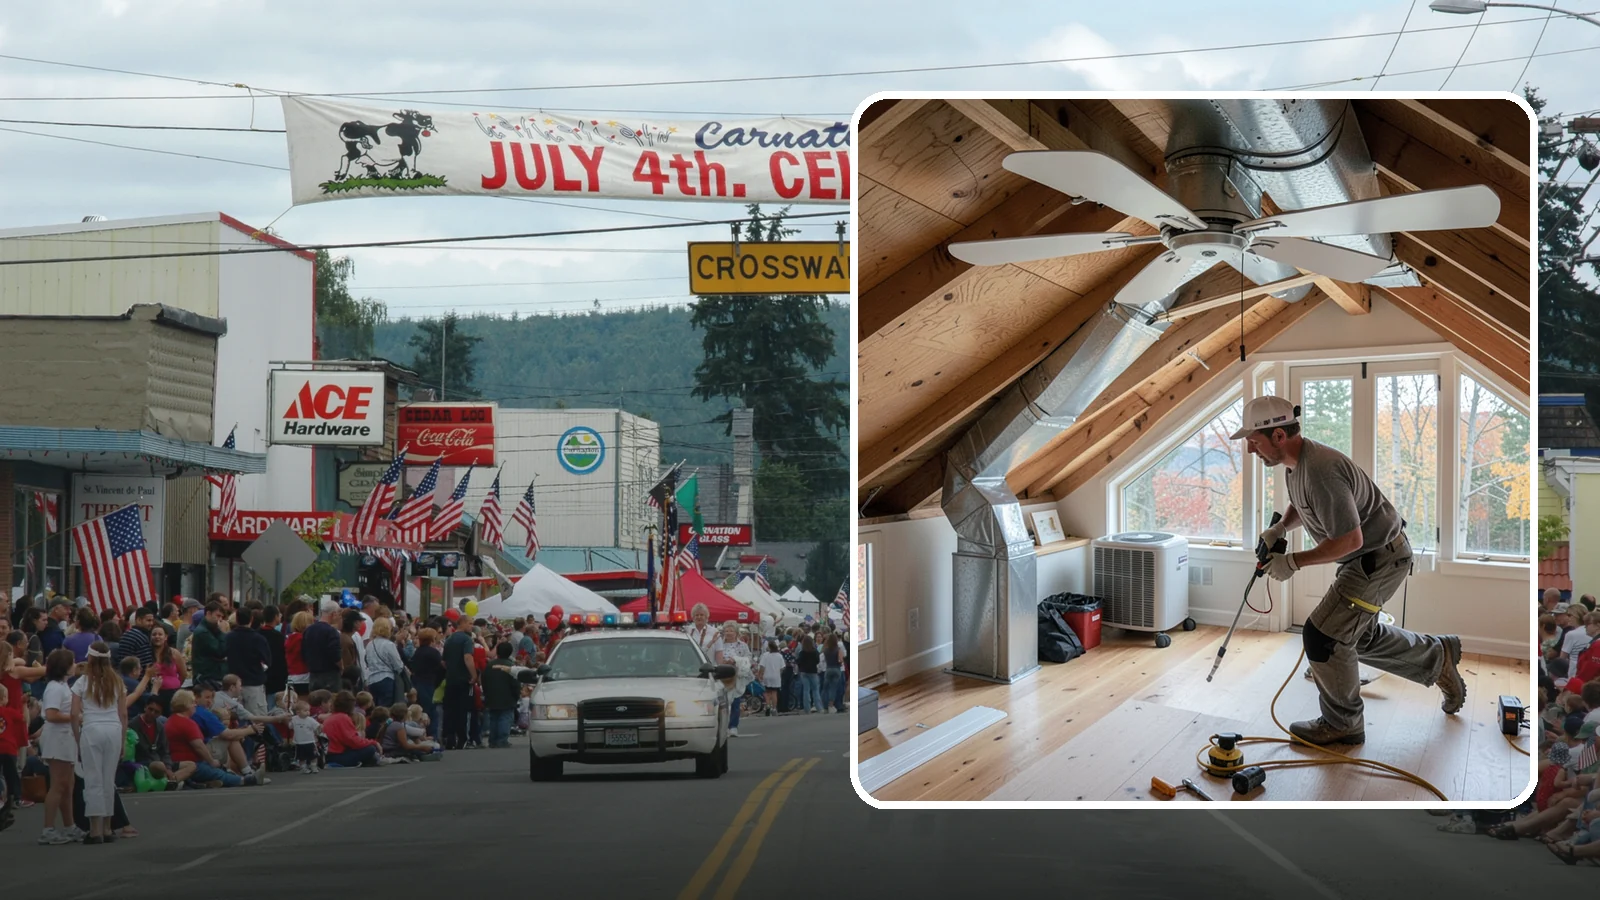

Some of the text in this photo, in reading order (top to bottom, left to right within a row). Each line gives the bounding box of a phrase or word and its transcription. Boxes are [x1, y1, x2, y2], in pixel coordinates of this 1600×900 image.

[481, 141, 604, 192] JULY
[632, 150, 746, 197] 4th.
[697, 254, 850, 279] CROSSWA
[282, 380, 373, 419] ACE
[405, 409, 485, 421] CEDAR LOG
[284, 421, 371, 436] Hardware
[416, 428, 477, 447] Coca-Cola
[354, 467, 384, 479] Simpl
[96, 485, 124, 494] Vincent
[126, 486, 136, 494] de
[138, 486, 155, 495] Paul
[212, 516, 330, 535] HARDARE
[688, 527, 741, 535] CRNATION
[699, 535, 730, 543] GLASS
